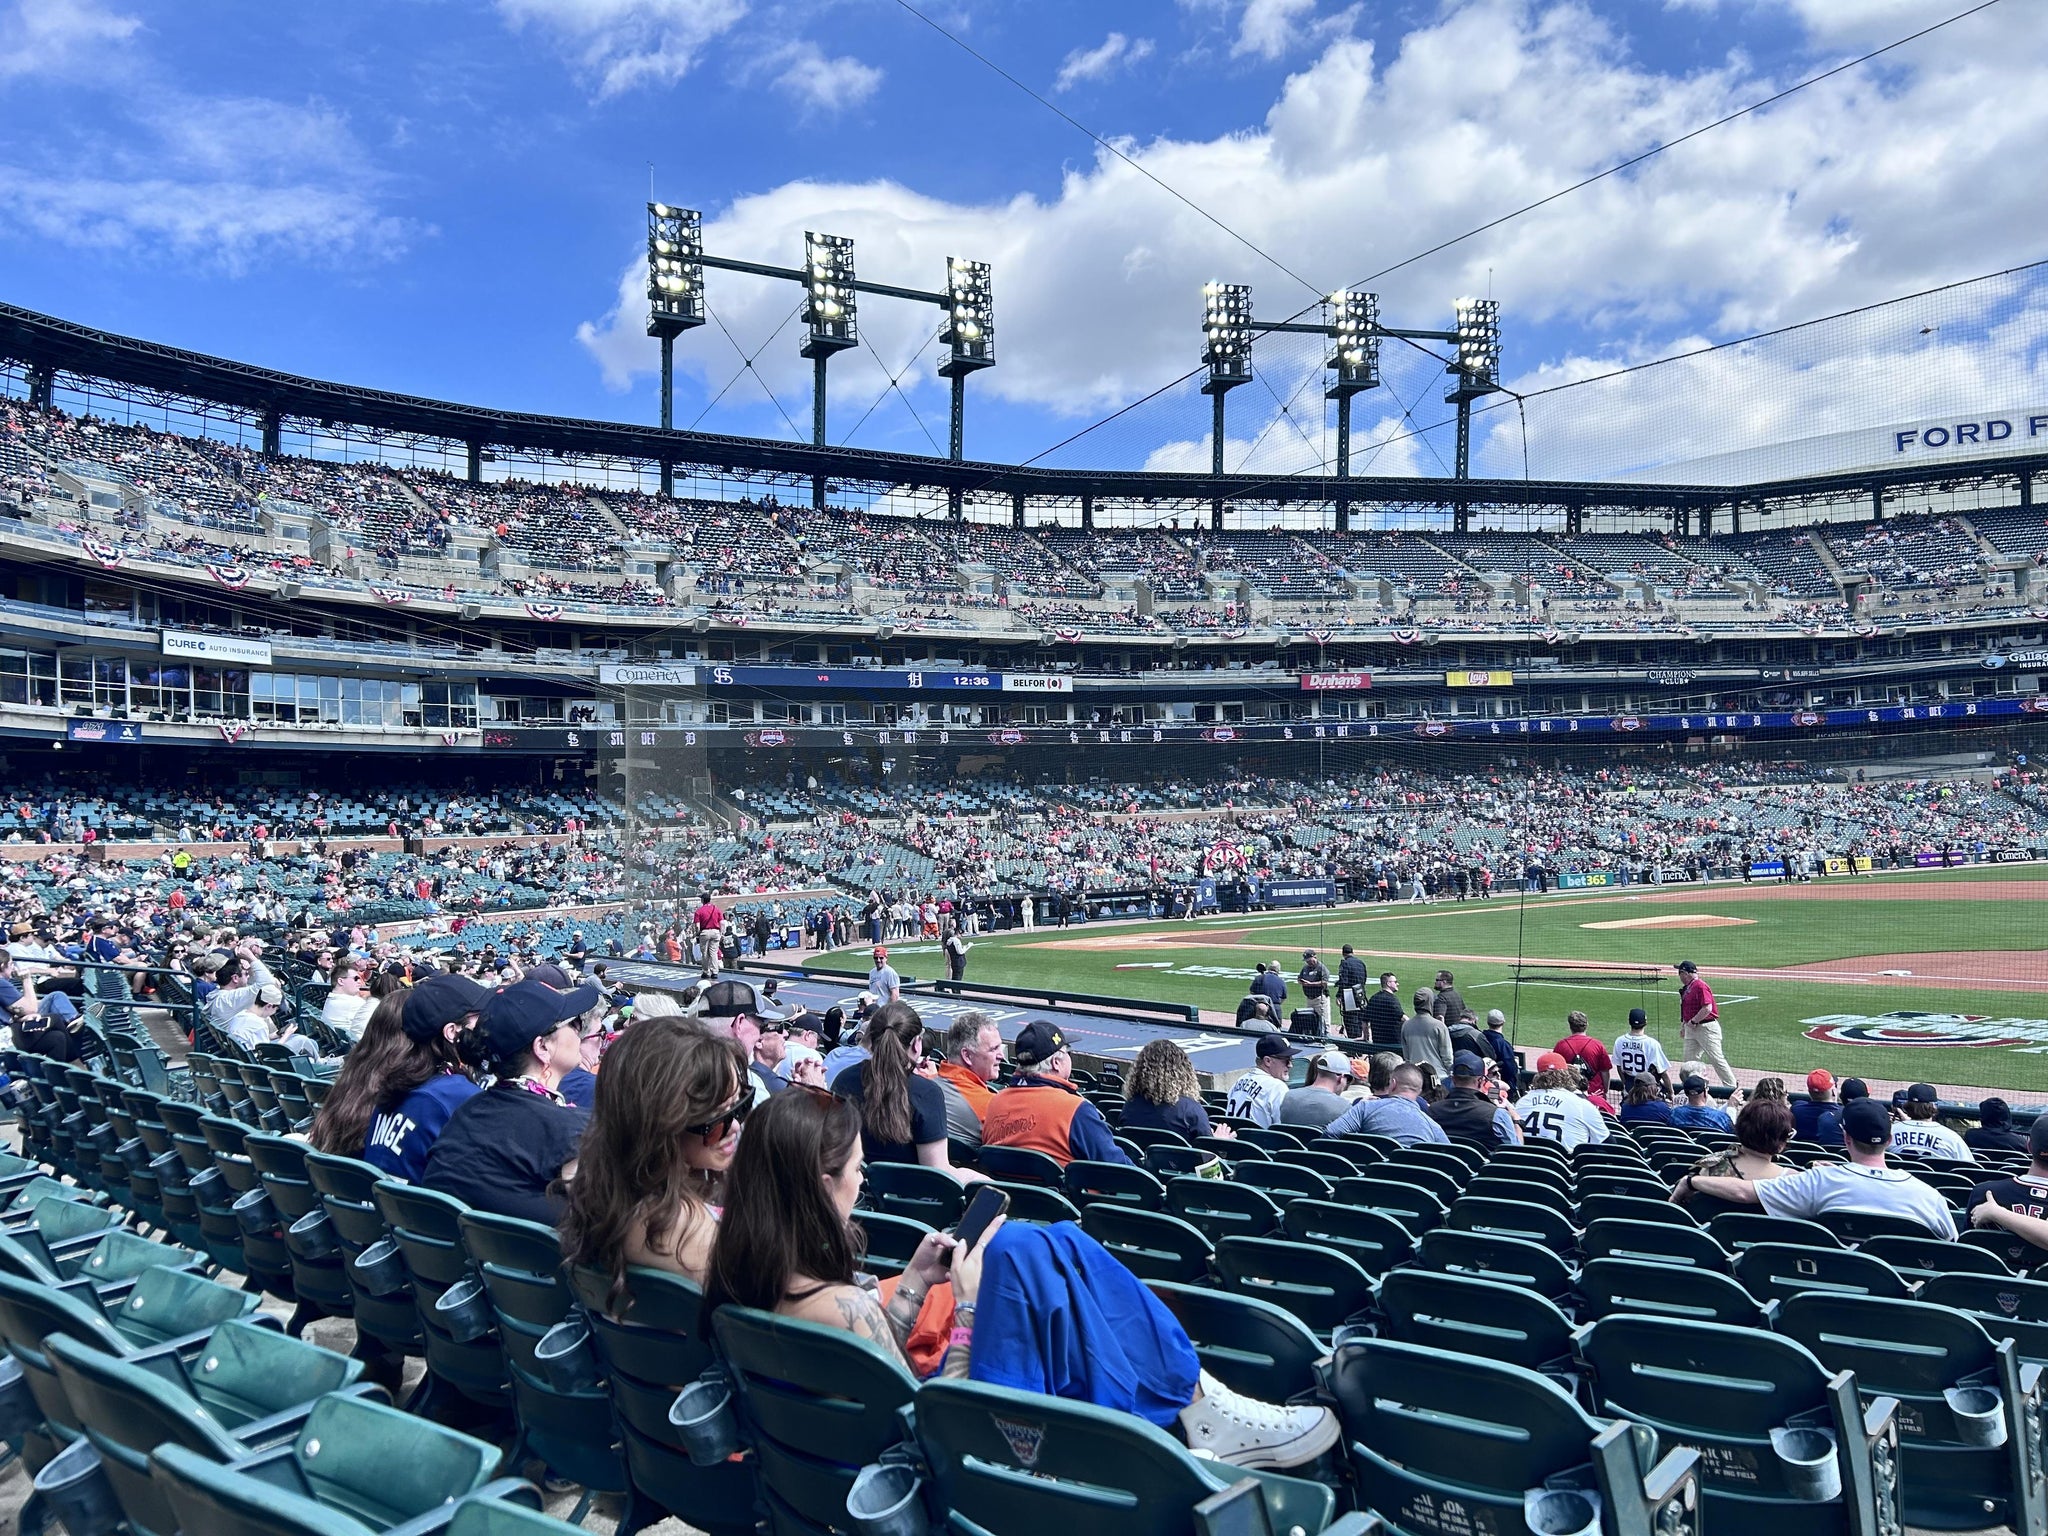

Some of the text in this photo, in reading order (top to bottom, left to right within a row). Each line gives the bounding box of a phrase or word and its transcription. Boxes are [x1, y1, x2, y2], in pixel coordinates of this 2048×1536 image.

[1896, 420, 2012, 452] FORD
[209, 645, 228, 653] AUTO
[229, 647, 269, 657] INSURANCE
[953, 676, 990, 686] 12:36
[1310, 673, 1362, 687] Dunham's
[1470, 672, 1488, 683] Lay's
[1649, 670, 1697, 679] CHAMPIONS
[1013, 678, 1045, 688] BELFOR
[1567, 874, 1607, 888] bet365
[1649, 869, 1692, 884] Cmerica
[1622, 1041, 1643, 1051] SKUBAL
[1621, 1051, 1646, 1072] 29
[1532, 1095, 1563, 1108] OLSON
[1523, 1111, 1565, 1142] 45
[370, 1113, 416, 1156] INGE
[1894, 1131, 1943, 1151] GREENE
